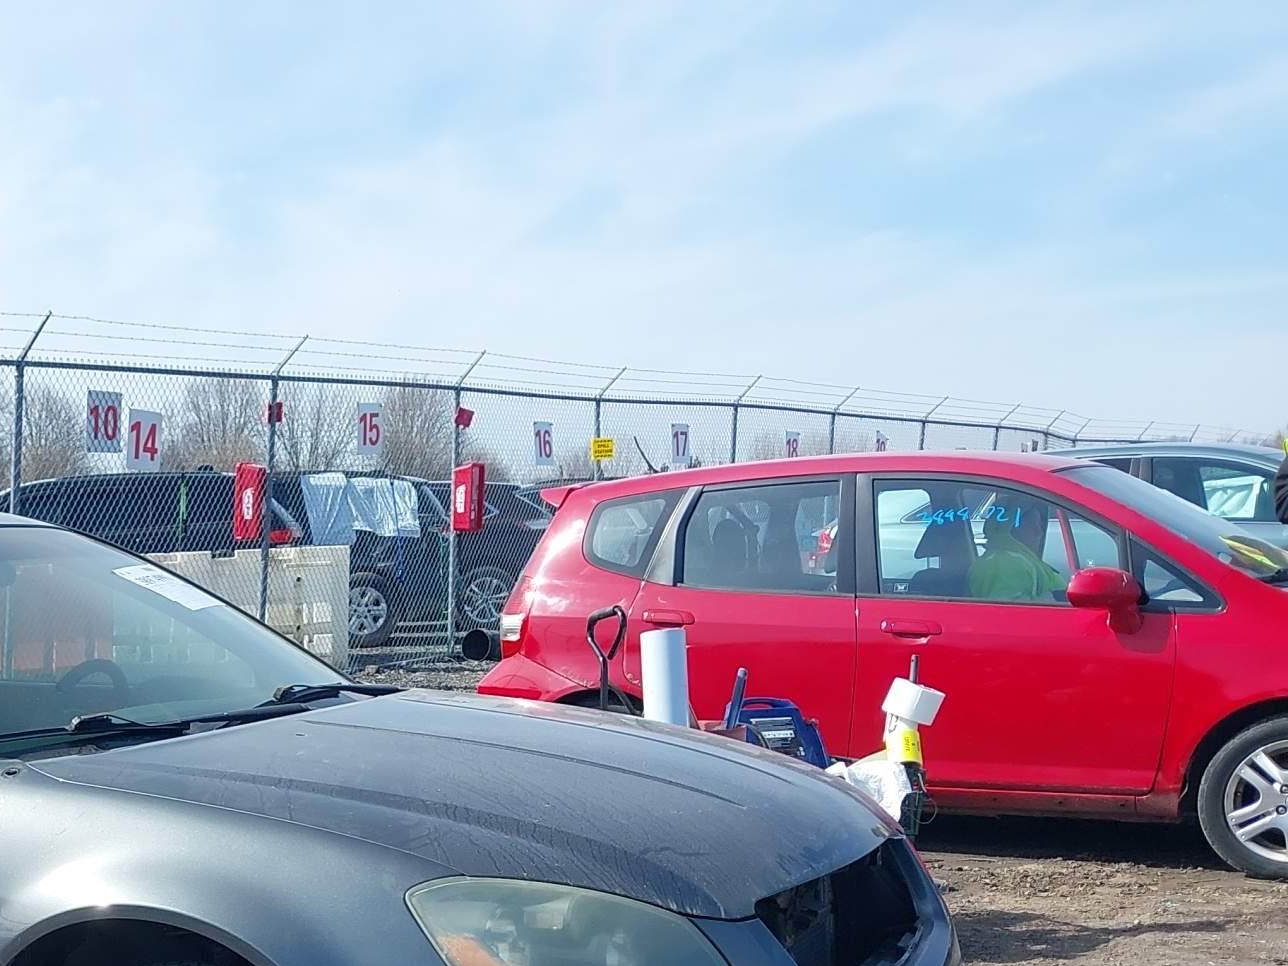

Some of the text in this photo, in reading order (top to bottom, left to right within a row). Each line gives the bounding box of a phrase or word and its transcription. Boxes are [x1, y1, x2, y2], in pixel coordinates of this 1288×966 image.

[90, 405, 118, 441] 10
[359, 412, 380, 446] 15
[130, 421, 158, 461] 14
[535, 430, 552, 458] 16
[672, 431, 688, 456] 17
[785, 438, 799, 458] 18
